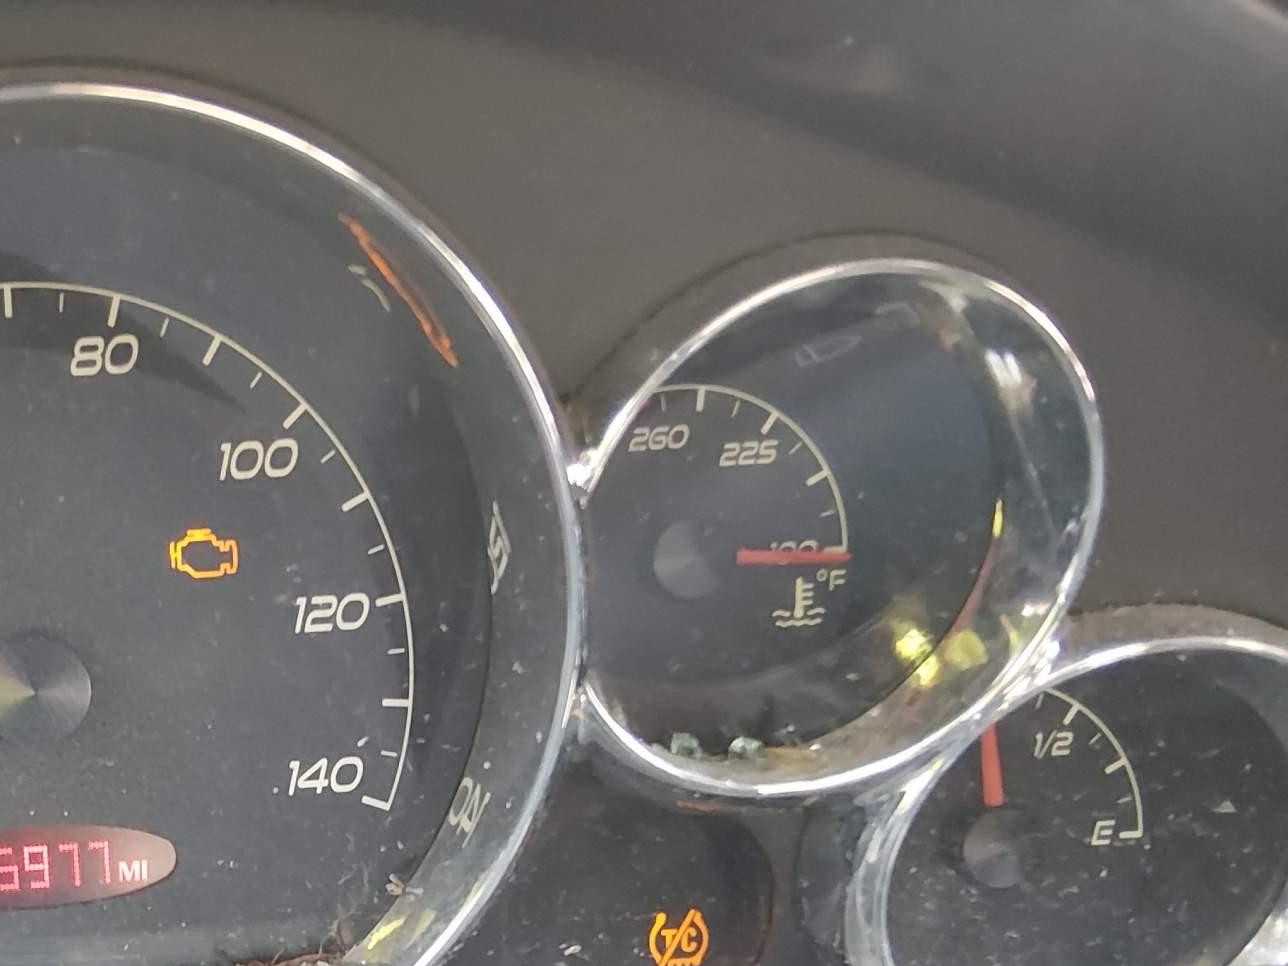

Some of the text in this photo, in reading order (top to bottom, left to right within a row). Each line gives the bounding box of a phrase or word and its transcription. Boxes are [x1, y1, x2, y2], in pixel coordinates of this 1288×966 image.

[68, 333, 139, 378] 80
[627, 423, 690, 453] 260
[718, 438, 779, 467] 225
[218, 437, 299, 482] 100
[294, 591, 370, 634] 120
[1033, 729, 1075, 759] 1/2
[287, 755, 365, 796] 140
[1090, 818, 1116, 847] E
[118, 859, 149, 883] MI
